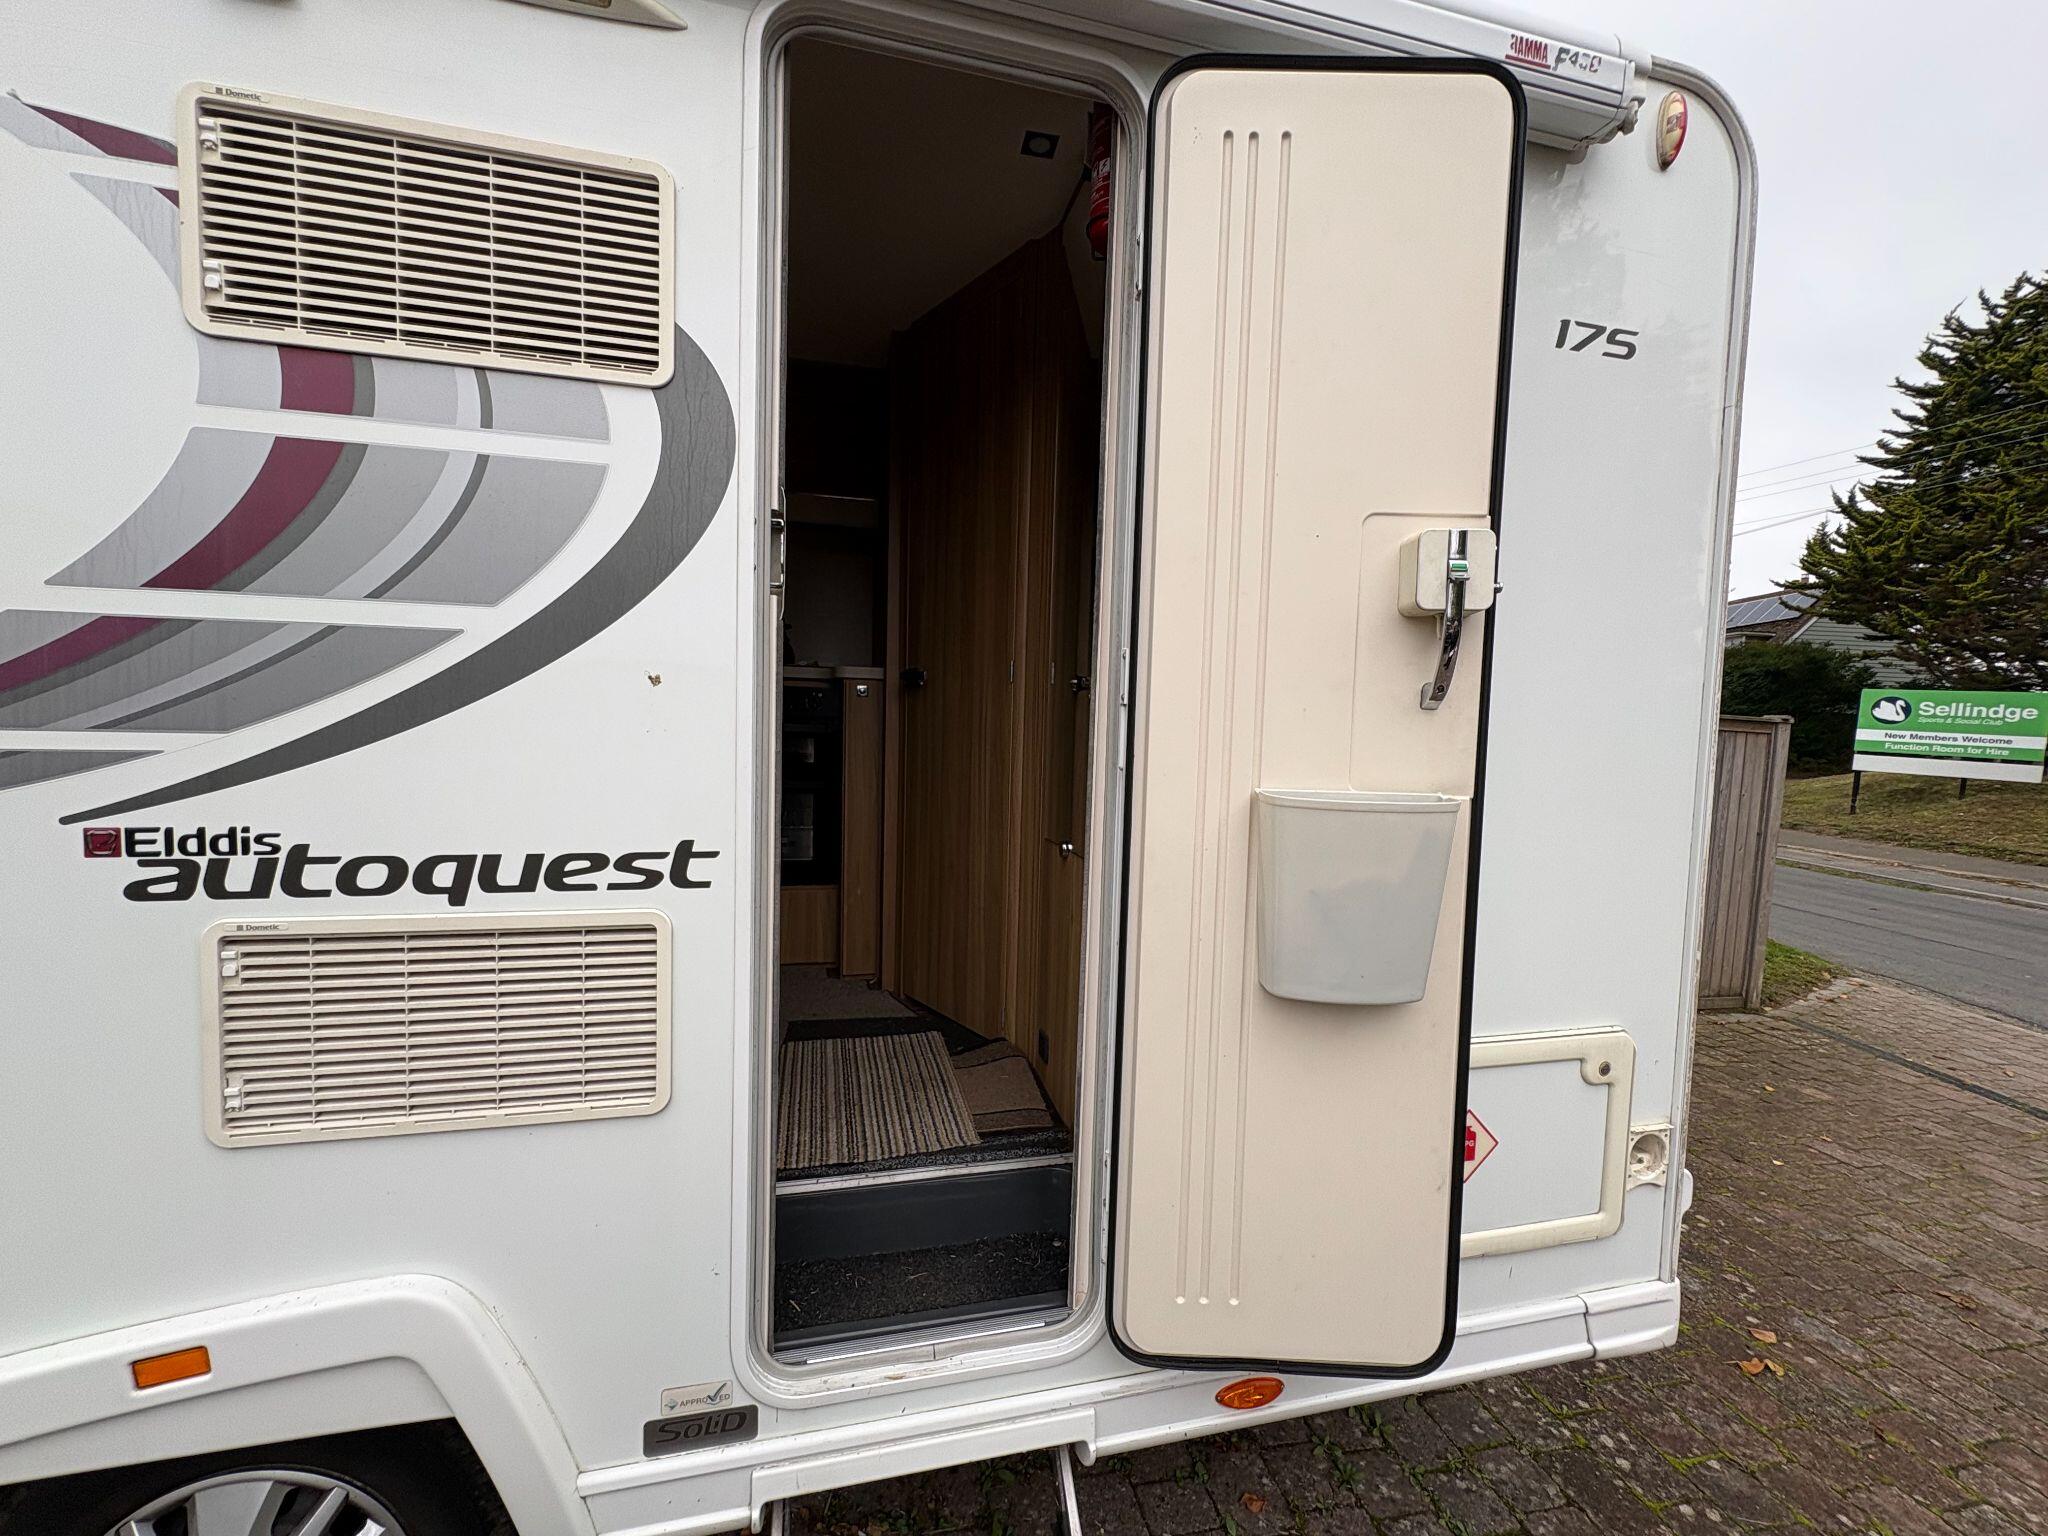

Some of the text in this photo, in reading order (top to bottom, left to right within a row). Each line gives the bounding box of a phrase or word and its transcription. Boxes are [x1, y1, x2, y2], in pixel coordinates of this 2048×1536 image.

[225, 88, 261, 101] Dometic
[1555, 318, 1640, 361] 17S
[1918, 701, 2039, 722] Sellindge
[1918, 716, 1945, 724] Sports
[1982, 718, 2004, 726] Club
[1884, 732, 2014, 745] New Members Welcome
[1884, 742, 2011, 756] Function Room for Hire
[124, 826, 282, 858] Elddis
[123, 839, 721, 907] autoquest
[245, 923, 280, 932] Dometic
